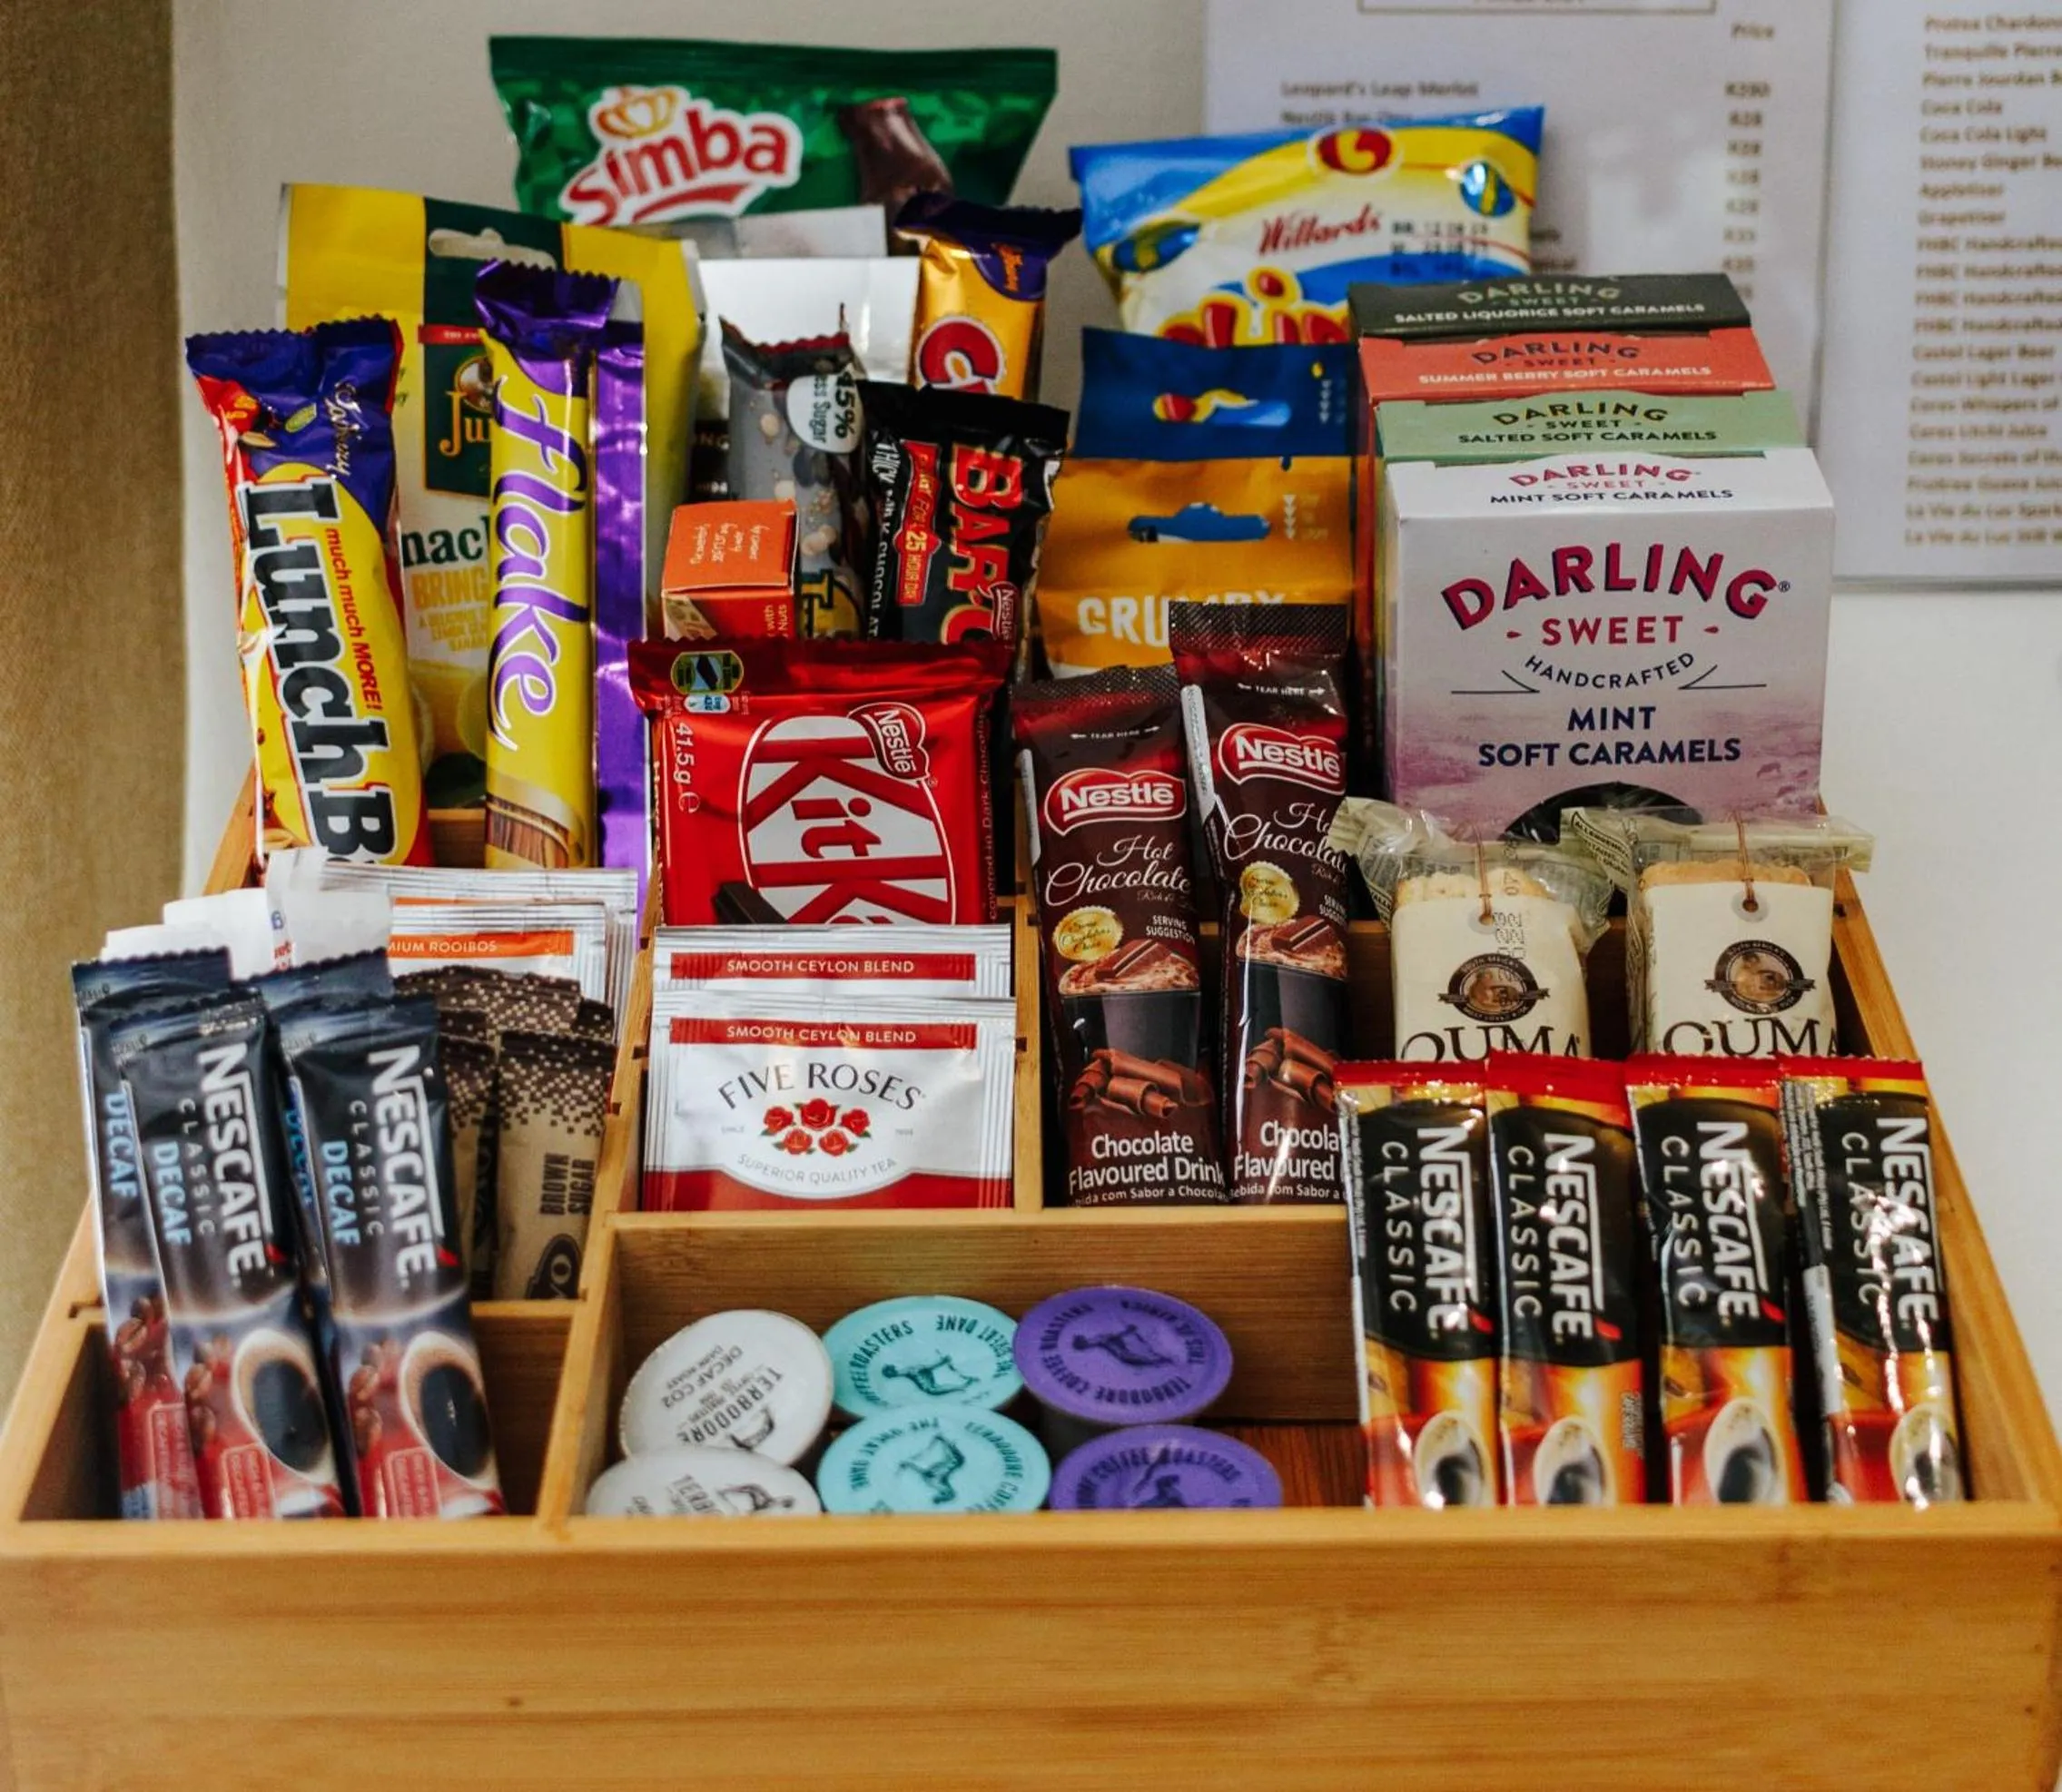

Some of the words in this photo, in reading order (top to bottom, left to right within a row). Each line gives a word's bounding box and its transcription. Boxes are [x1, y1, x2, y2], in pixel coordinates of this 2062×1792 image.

[568, 106, 788, 226] Simba
[1457, 281, 1623, 305] DARLING
[1394, 310, 1458, 324] SALTED
[1564, 305, 1606, 318] SOFT
[1609, 302, 1705, 316] CARAMELS
[1471, 340, 1642, 365] DARLING
[1418, 371, 1498, 385] SUMMER
[1502, 369, 1559, 382] BERRY
[1563, 367, 1609, 380] SOFT
[1613, 365, 1712, 379] CARAMELS
[1493, 400, 1669, 426] DARLING
[1545, 419, 1621, 430] SWEET
[1458, 433, 1535, 445] SALTED
[1541, 431, 1594, 443] SOFT
[1600, 428, 1718, 442] CARAMELS
[1508, 463, 1693, 487] DARLING
[1567, 480, 1645, 490] SWEET
[1490, 493, 1547, 505] MINT
[1552, 491, 1608, 503] SOFT
[1613, 489, 1733, 502] CARAMELS
[324, 527, 350, 583] much
[1441, 542, 1777, 631] DARLING
[338, 584, 365, 637] much
[237, 477, 392, 795] Lunch
[1541, 615, 1684, 646] SWEET
[350, 638, 383, 711] MORE!
[1524, 652, 1695, 689] HANDCRAFTED
[1567, 705, 1657, 733] MINT
[676, 722, 695, 766] 41.5
[1478, 743, 1560, 767] SOFT
[1568, 738, 1741, 766] CARAMELS
[744, 736, 950, 925] KitK
[1097, 836, 1173, 867] Hot
[1045, 862, 1192, 907] Chocolate
[429, 940, 498, 953] ROOIBOS
[726, 959, 794, 973] SMOOTH
[797, 960, 862, 973] CEYLON
[864, 960, 914, 973] BLEND
[726, 1025, 794, 1040] SMOOTH
[799, 1027, 861, 1043] CEYLON
[865, 1030, 917, 1043] BLEND
[718, 1064, 794, 1110] FIVE
[808, 1062, 922, 1111] ROSES
[104, 1092, 138, 1198] DECAF
[1090, 1131, 1194, 1159] Chocolate
[1259, 1122, 1340, 1153] Chocola
[179, 1099, 216, 1236] CLASSIC
[349, 1099, 386, 1236] CLASSIC
[539, 1152, 569, 1215] BROWN
[737, 1152, 805, 1184] SUPERIOR
[809, 1165, 867, 1186] QUALITY
[869, 1157, 897, 1174] TEA
[1069, 1159, 1170, 1195] Flavoured
[1174, 1157, 1226, 1186] Drink
[1233, 1155, 1336, 1181] Flavoured
[151, 1141, 191, 1246] DECAF
[321, 1140, 361, 1246] DECAF
[567, 1159, 596, 1215] SUGAR
[1101, 1190, 1128, 1200] com
[1130, 1186, 1166, 1199] Sabor
[1168, 1188, 1176, 1196] a
[1296, 1184, 1330, 1197] Sabor
[1381, 1141, 1417, 1313] CLASSIC
[1506, 1146, 1543, 1318] CLASSIC
[1661, 1135, 1707, 1306] CLASSIC
[1841, 1131, 1882, 1306] CLASSIC
[936, 1314, 979, 1334] DANE
